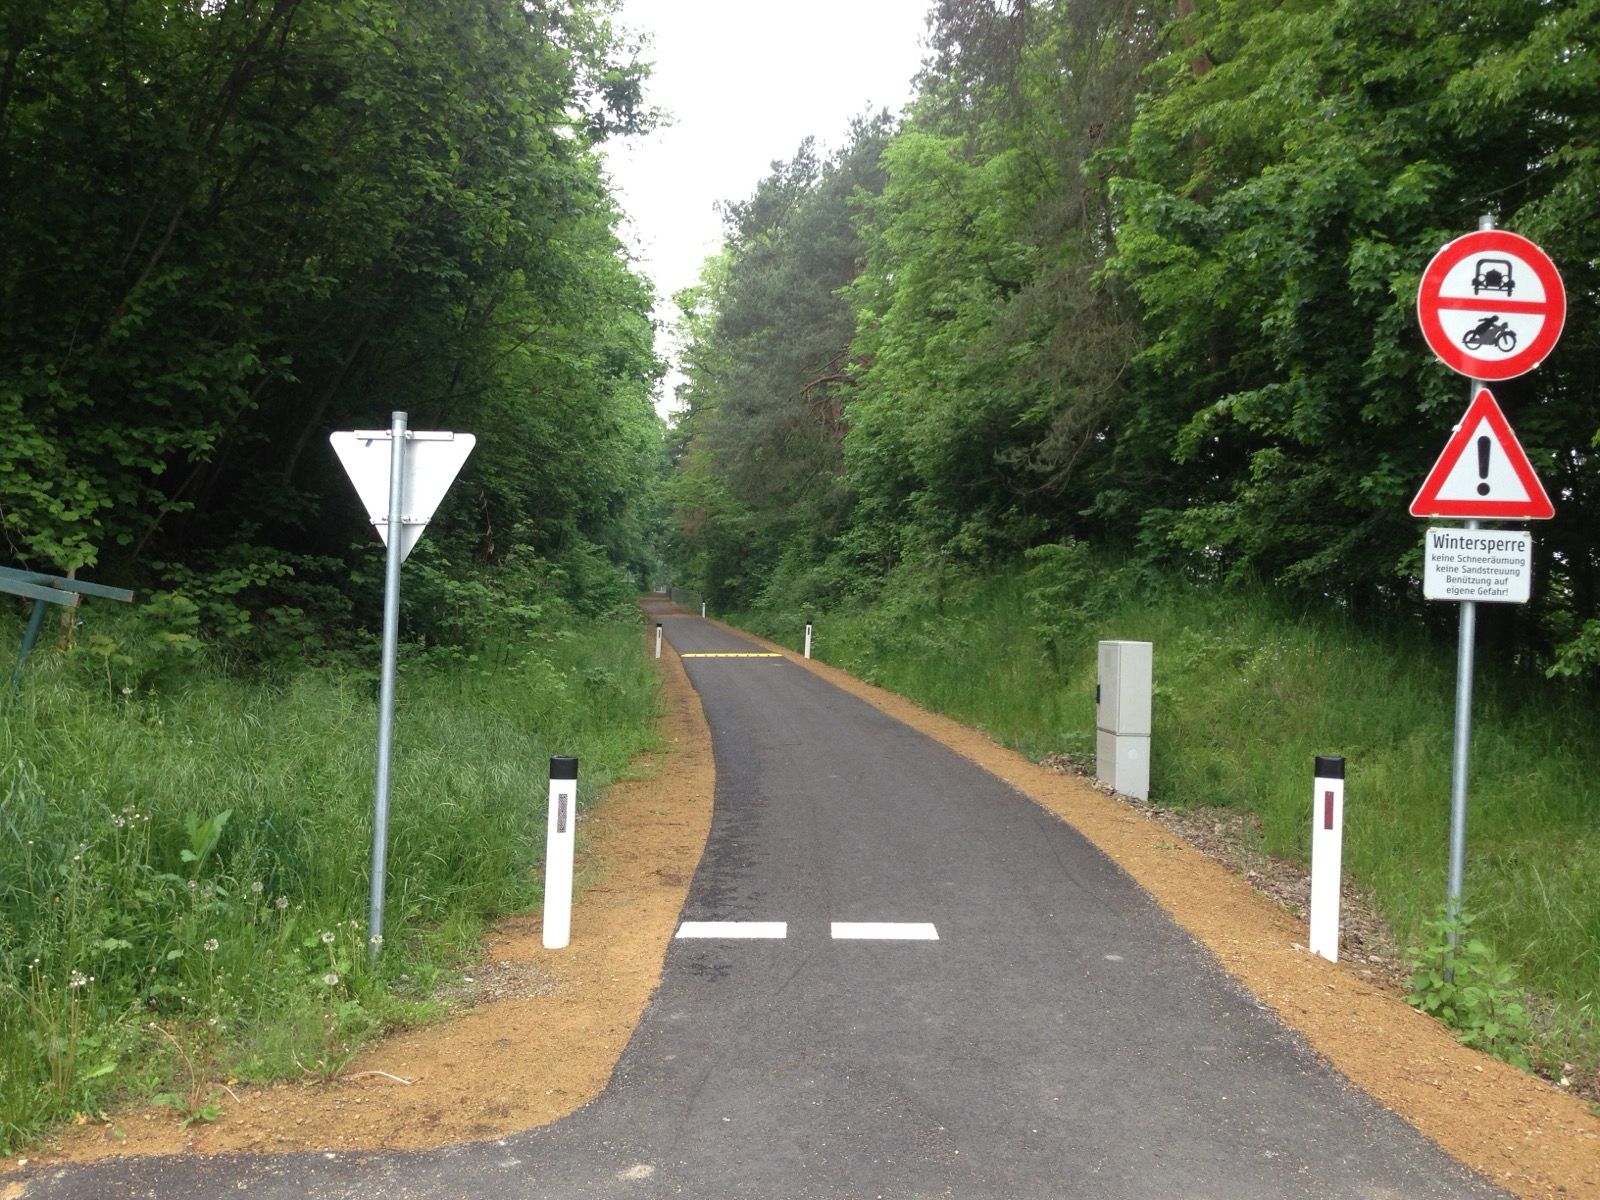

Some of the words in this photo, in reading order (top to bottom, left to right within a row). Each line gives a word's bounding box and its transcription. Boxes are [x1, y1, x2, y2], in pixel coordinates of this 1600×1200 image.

[1433, 533, 1526, 554] Wintersperre
[1431, 553, 1455, 563] keine
[1457, 554, 1526, 567] Schneeräumung
[1435, 564, 1459, 574] keine
[1461, 565, 1521, 577] Sandstreuung
[1446, 575, 1492, 586] Benützung
[1494, 577, 1509, 586] auf
[1446, 586, 1475, 595] eigene
[1477, 587, 1509, 597] Gefahr!
